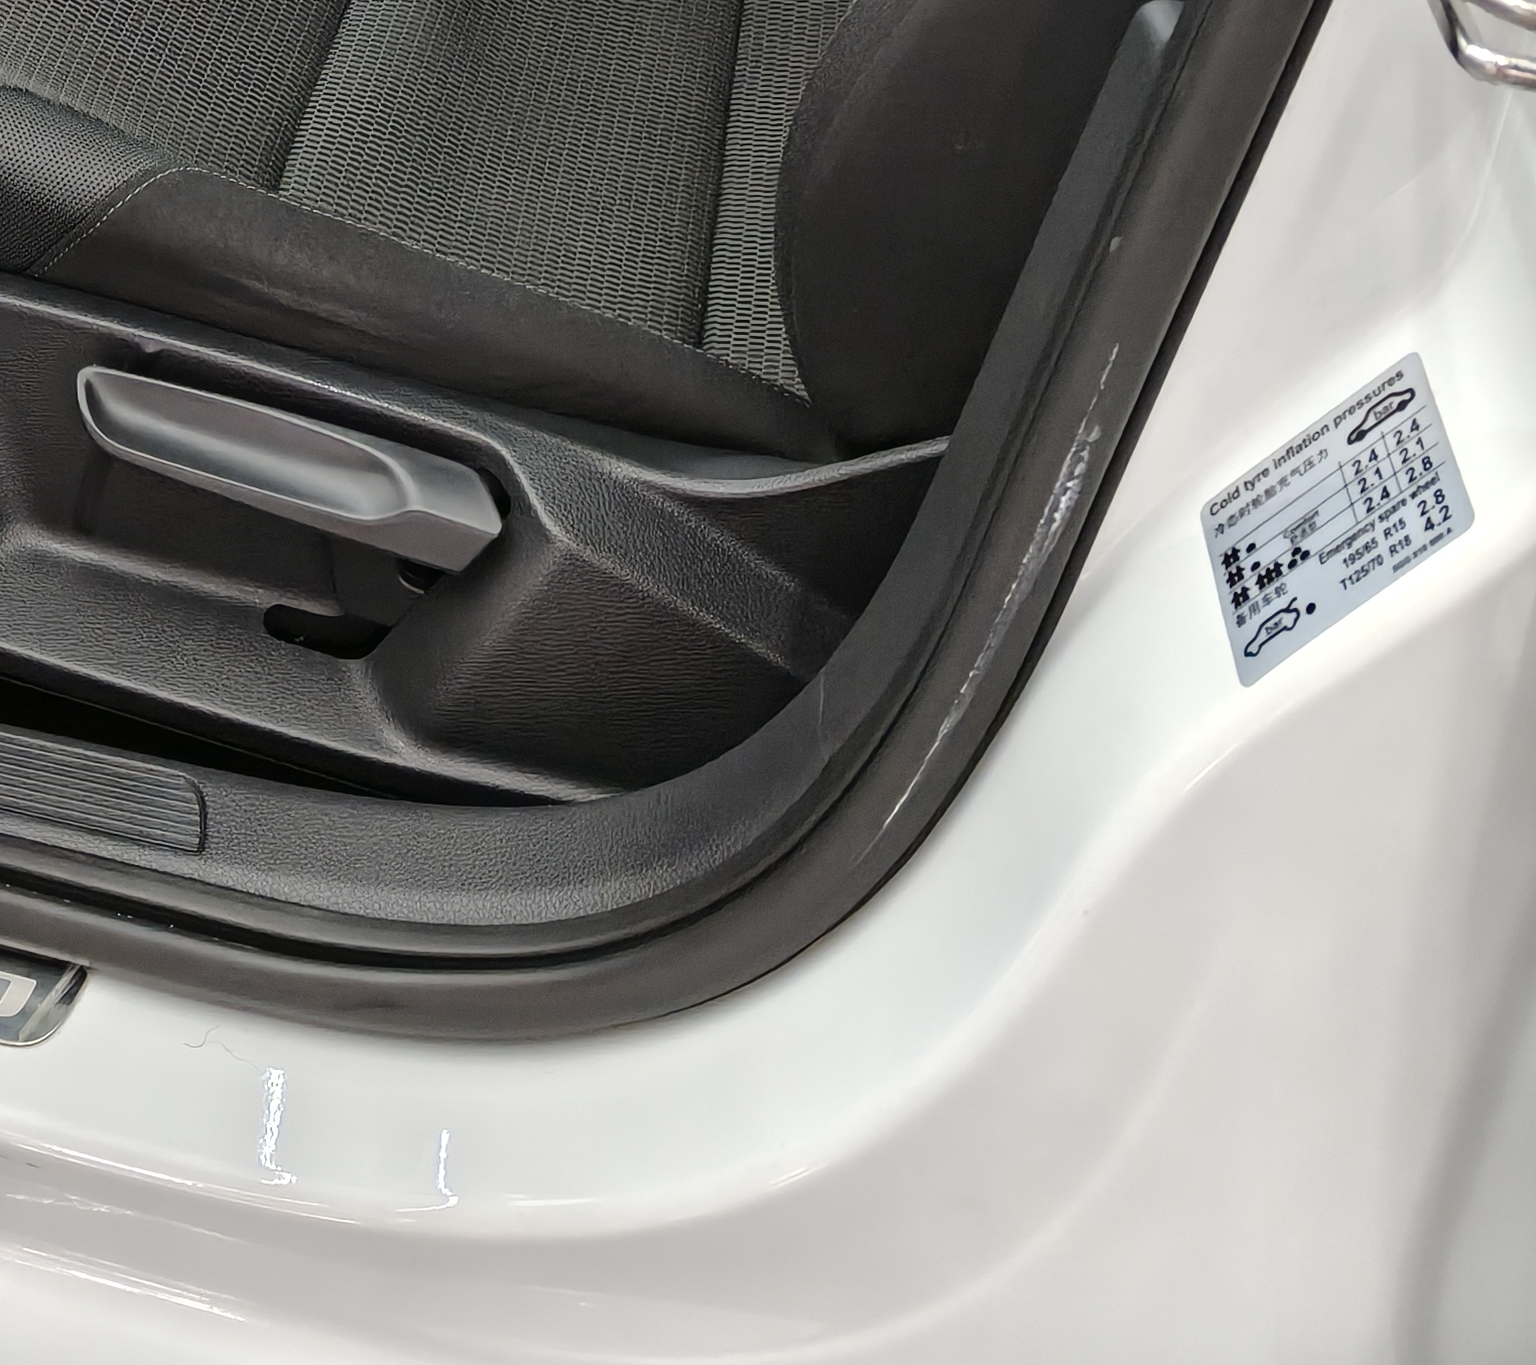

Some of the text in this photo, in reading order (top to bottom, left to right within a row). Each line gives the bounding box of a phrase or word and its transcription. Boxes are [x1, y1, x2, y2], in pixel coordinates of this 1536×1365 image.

[1374, 400, 1392, 419] bar
[1210, 370, 1403, 515] Cold tyre inflation pressures
[1352, 418, 1419, 475] 2.4 2.4
[1358, 437, 1423, 493] 2.1 2.1
[1364, 455, 1432, 512] 2.4 2.8
[1418, 488, 1444, 516] 2.8
[1320, 518, 1375, 566] Emergency
[1423, 505, 1450, 533] 4.2
